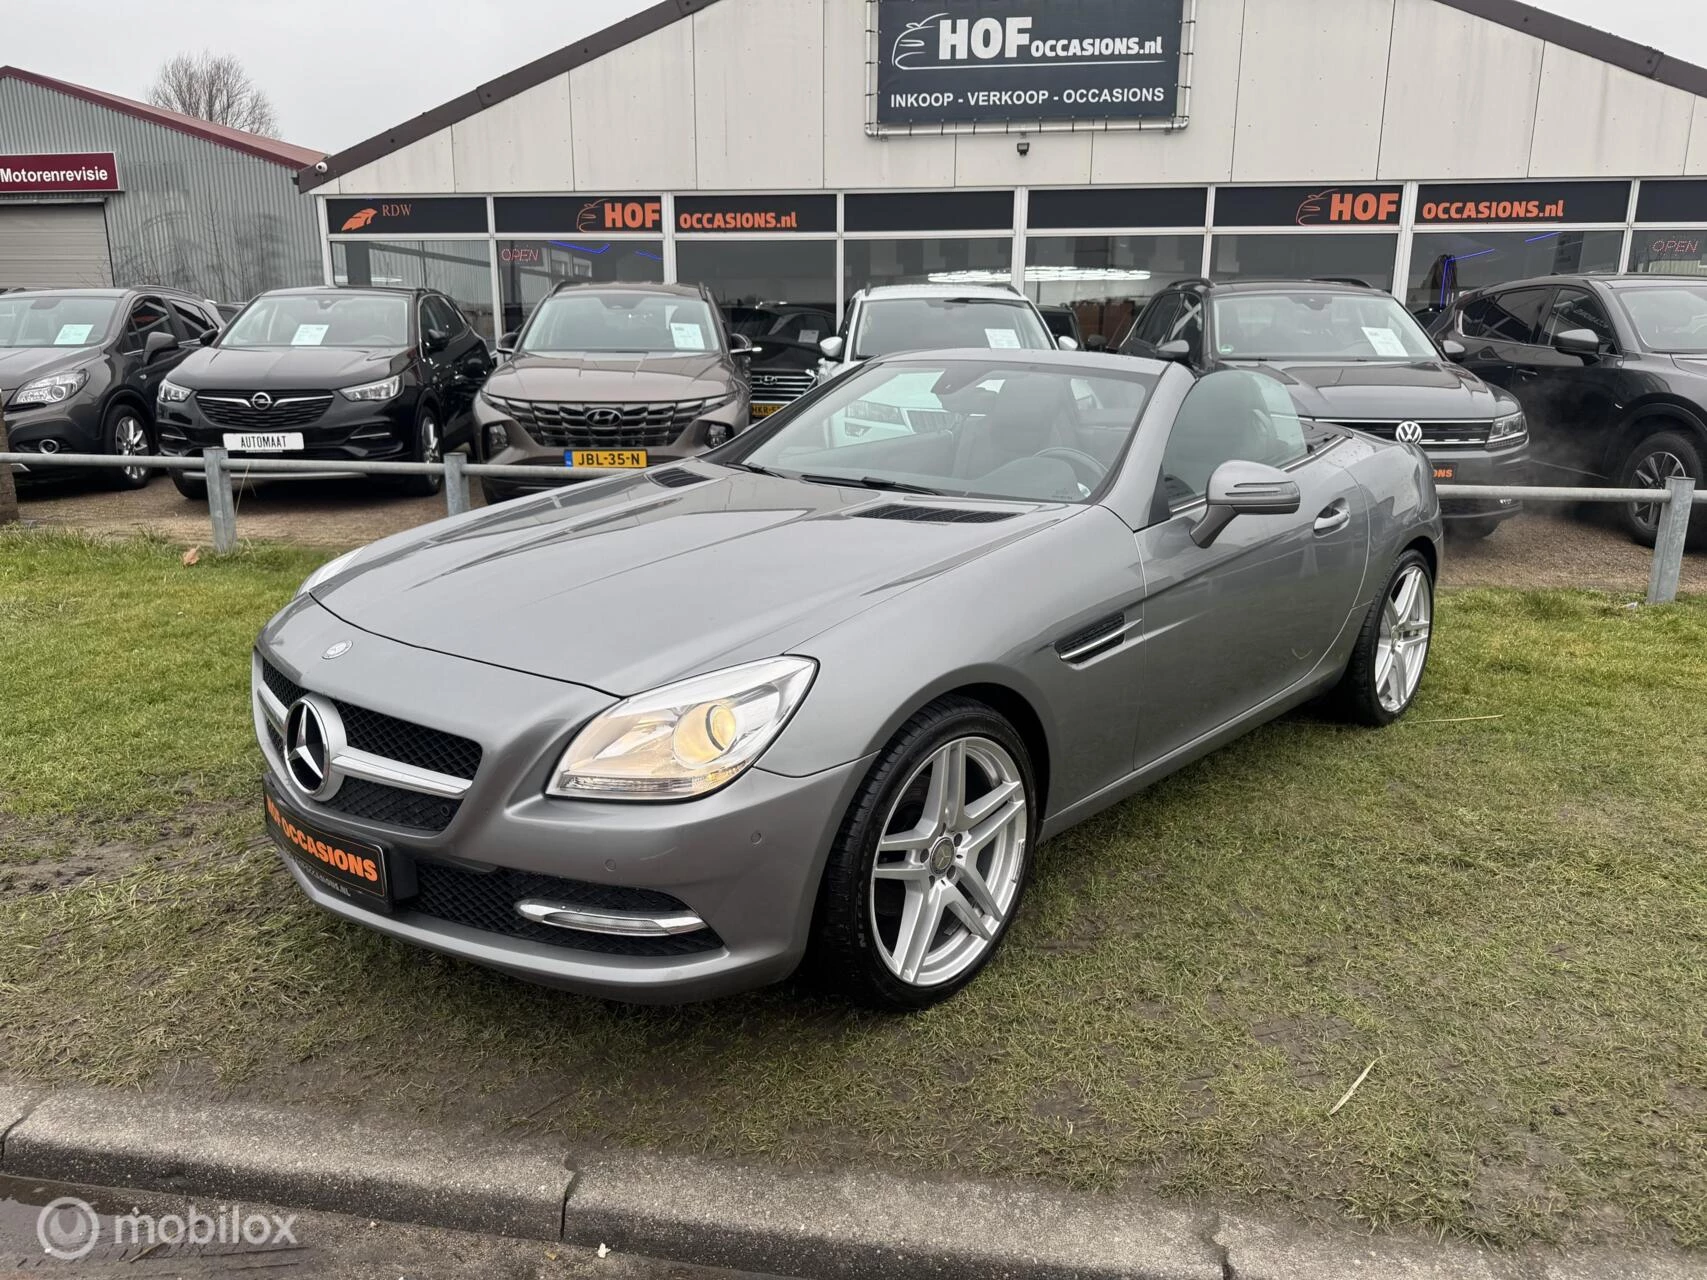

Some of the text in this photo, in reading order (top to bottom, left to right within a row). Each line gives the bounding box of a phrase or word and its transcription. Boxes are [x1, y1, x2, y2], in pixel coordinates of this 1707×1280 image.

[938, 16, 1163, 60] HOF OCCASIONS.nl
[891, 93, 954, 108] INKOOP
[967, 90, 1048, 106] VERKOOP
[1063, 87, 1164, 104] OCCASIONS
[0, 166, 108, 182] Motorenrevisie
[382, 204, 412, 217] RDW
[1329, 193, 1564, 221] HOF OCCASIONS.nl
[604, 202, 797, 229] HOF OCCASIONS.nl
[1652, 240, 1699, 253] OPEN
[501, 248, 539, 262] OPEN
[241, 436, 287, 448] AUTOMAAT
[578, 453, 640, 466] JBL-35-N
[281, 816, 378, 881] OCCASIONS
